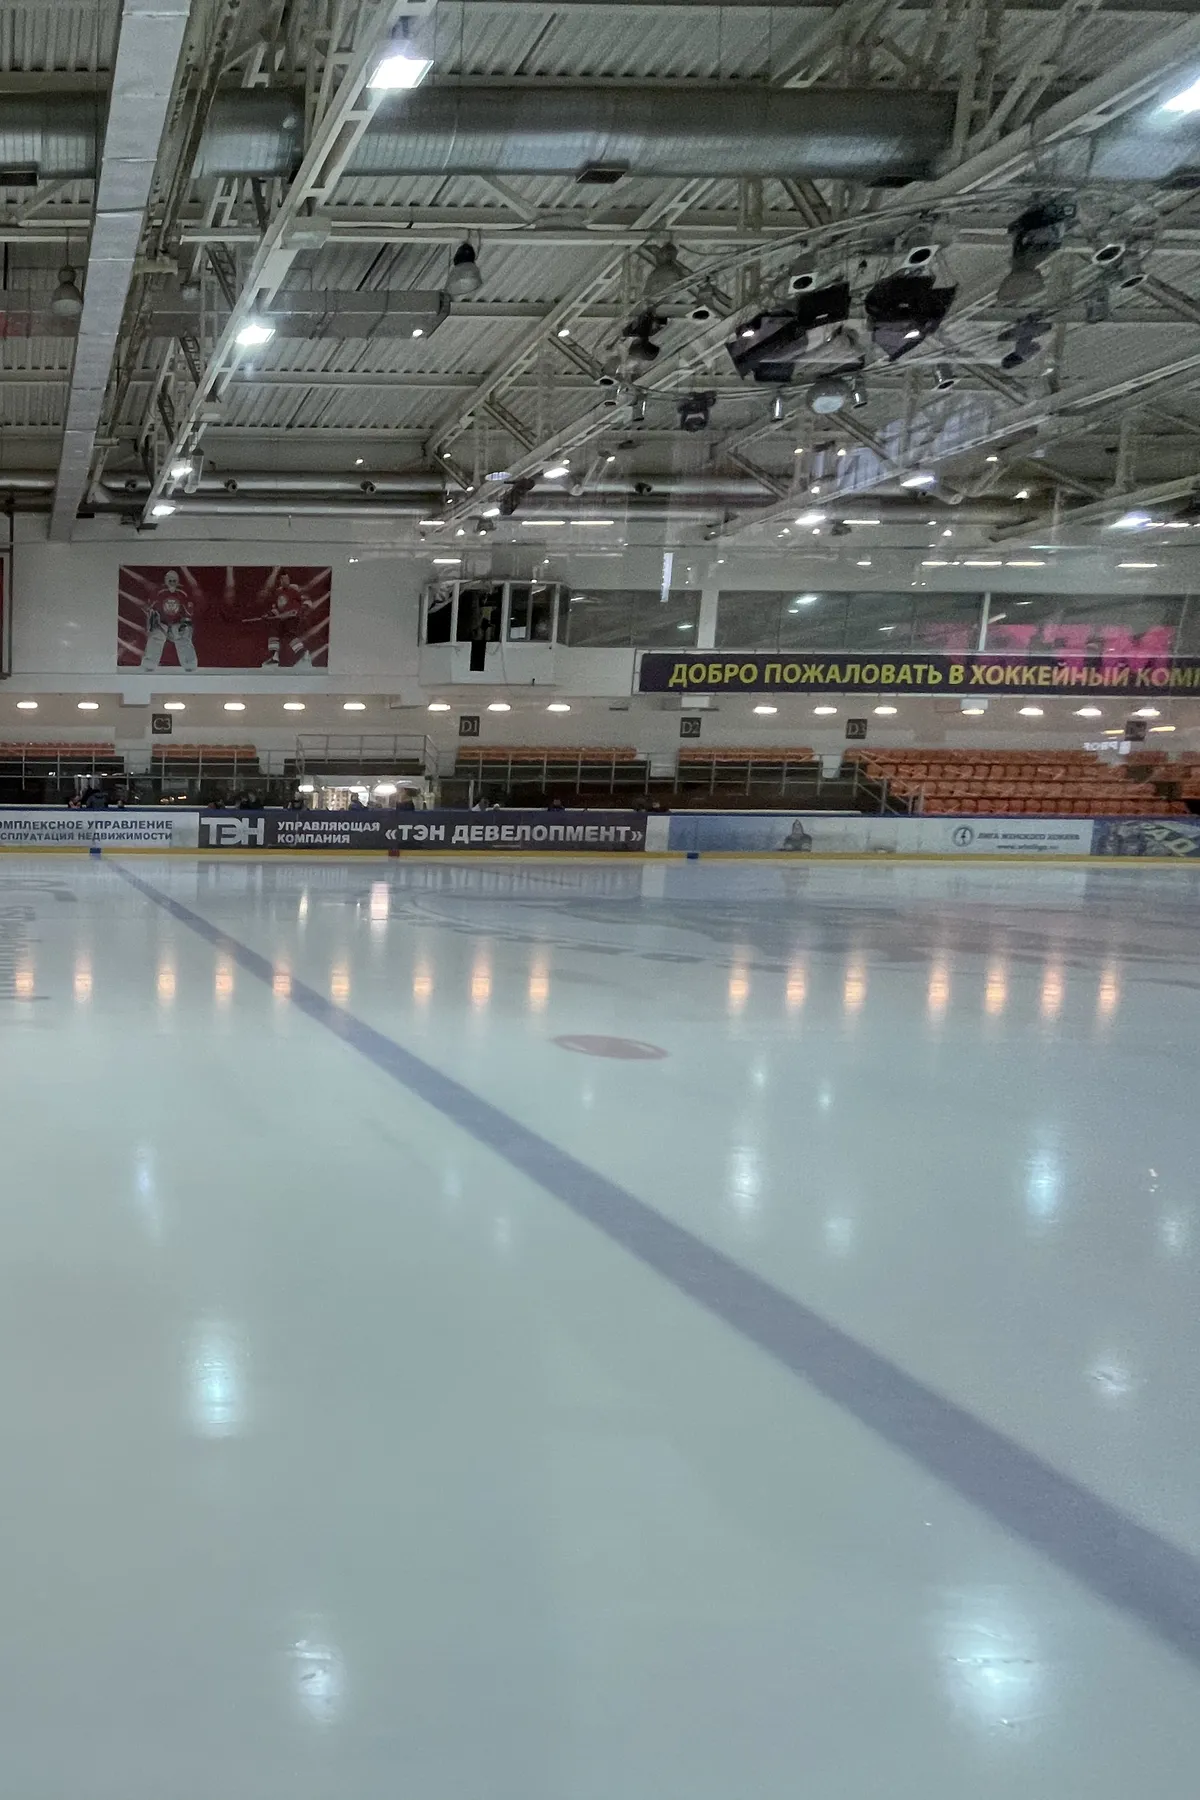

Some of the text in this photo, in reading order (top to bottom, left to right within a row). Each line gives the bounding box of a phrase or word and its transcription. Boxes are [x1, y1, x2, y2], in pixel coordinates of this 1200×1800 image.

[668, 663, 758, 688] ДОБРО
[764, 663, 943, 685] ПОЖАЛОВАТЬ
[949, 665, 965, 685] В
[969, 662, 1130, 687] ХОККЕЙНЫЙ
[153, 718, 171, 730] C3
[460, 720, 478, 733] D1
[681, 722, 700, 735] D2
[87, 820, 173, 830] УПРАВЛЕНИЕ
[277, 821, 381, 832] УПРАВЛЯЮЩАЯ
[78, 832, 173, 842] НЕДВИЖИМОСТИ
[200, 817, 265, 846] ТЭН
[385, 825, 643, 844] «ТЭН ДЕВЕЛОПМЕНТ»
[277, 833, 350, 844] КОМПАНИЯ
